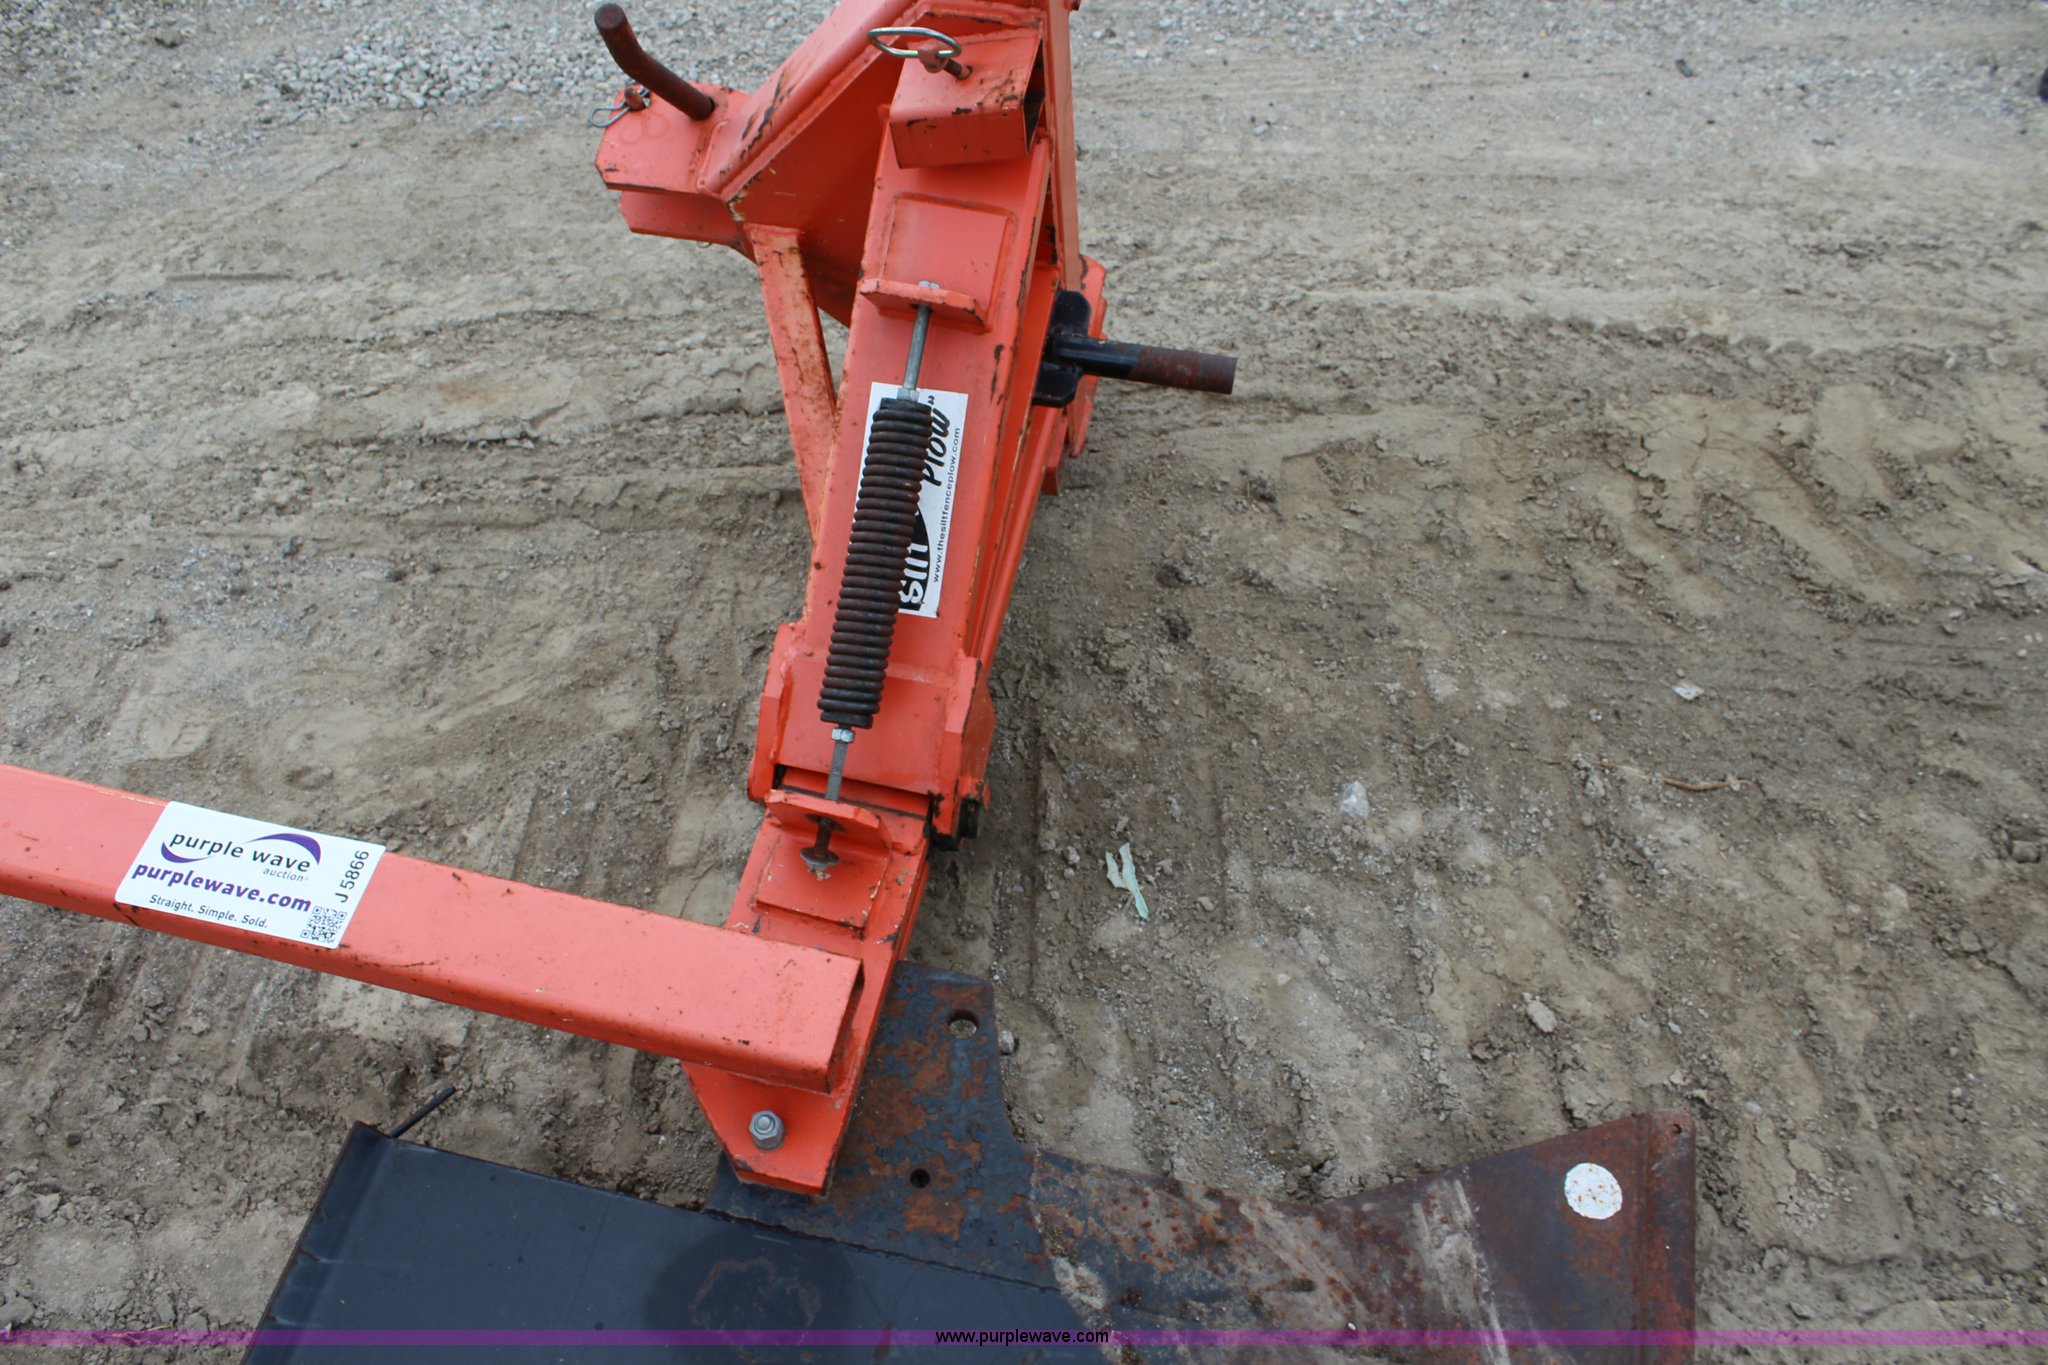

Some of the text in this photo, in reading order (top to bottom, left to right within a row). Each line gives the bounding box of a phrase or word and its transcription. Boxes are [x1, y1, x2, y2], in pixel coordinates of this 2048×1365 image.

[933, 427, 960, 583] www.thesiltfenceplow.com
[169, 834, 311, 872] purple wave
[132, 864, 311, 912] purplewave.com
[262, 867, 303, 882] auction
[149, 894, 268, 928] Straight. Simple. Sold.
